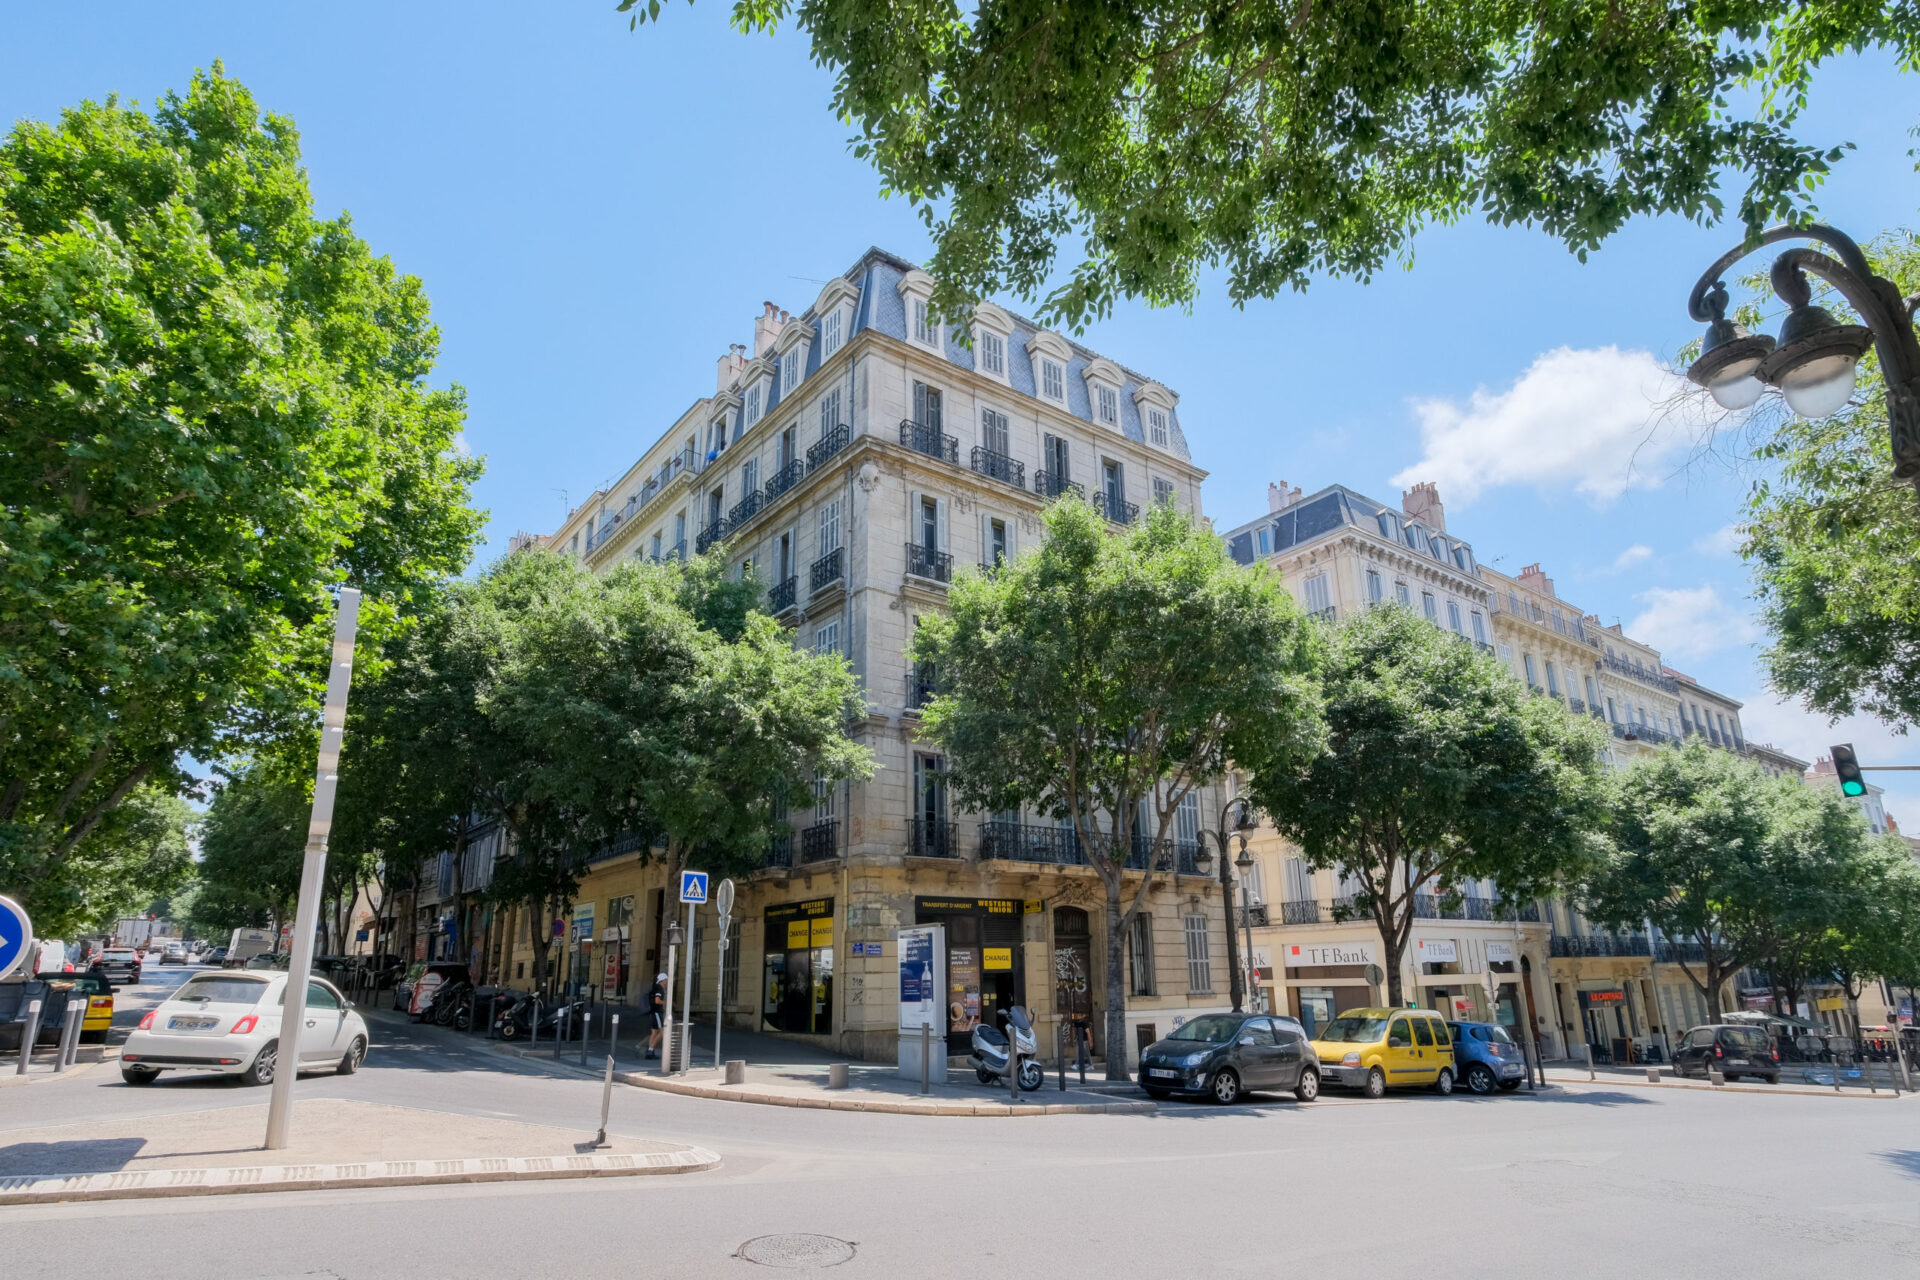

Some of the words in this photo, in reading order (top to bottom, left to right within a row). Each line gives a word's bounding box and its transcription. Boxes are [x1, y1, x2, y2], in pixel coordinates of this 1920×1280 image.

[977, 899, 1012, 907] WESTERN
[789, 929, 808, 938] CHANGE
[812, 927, 833, 936] CHANGE
